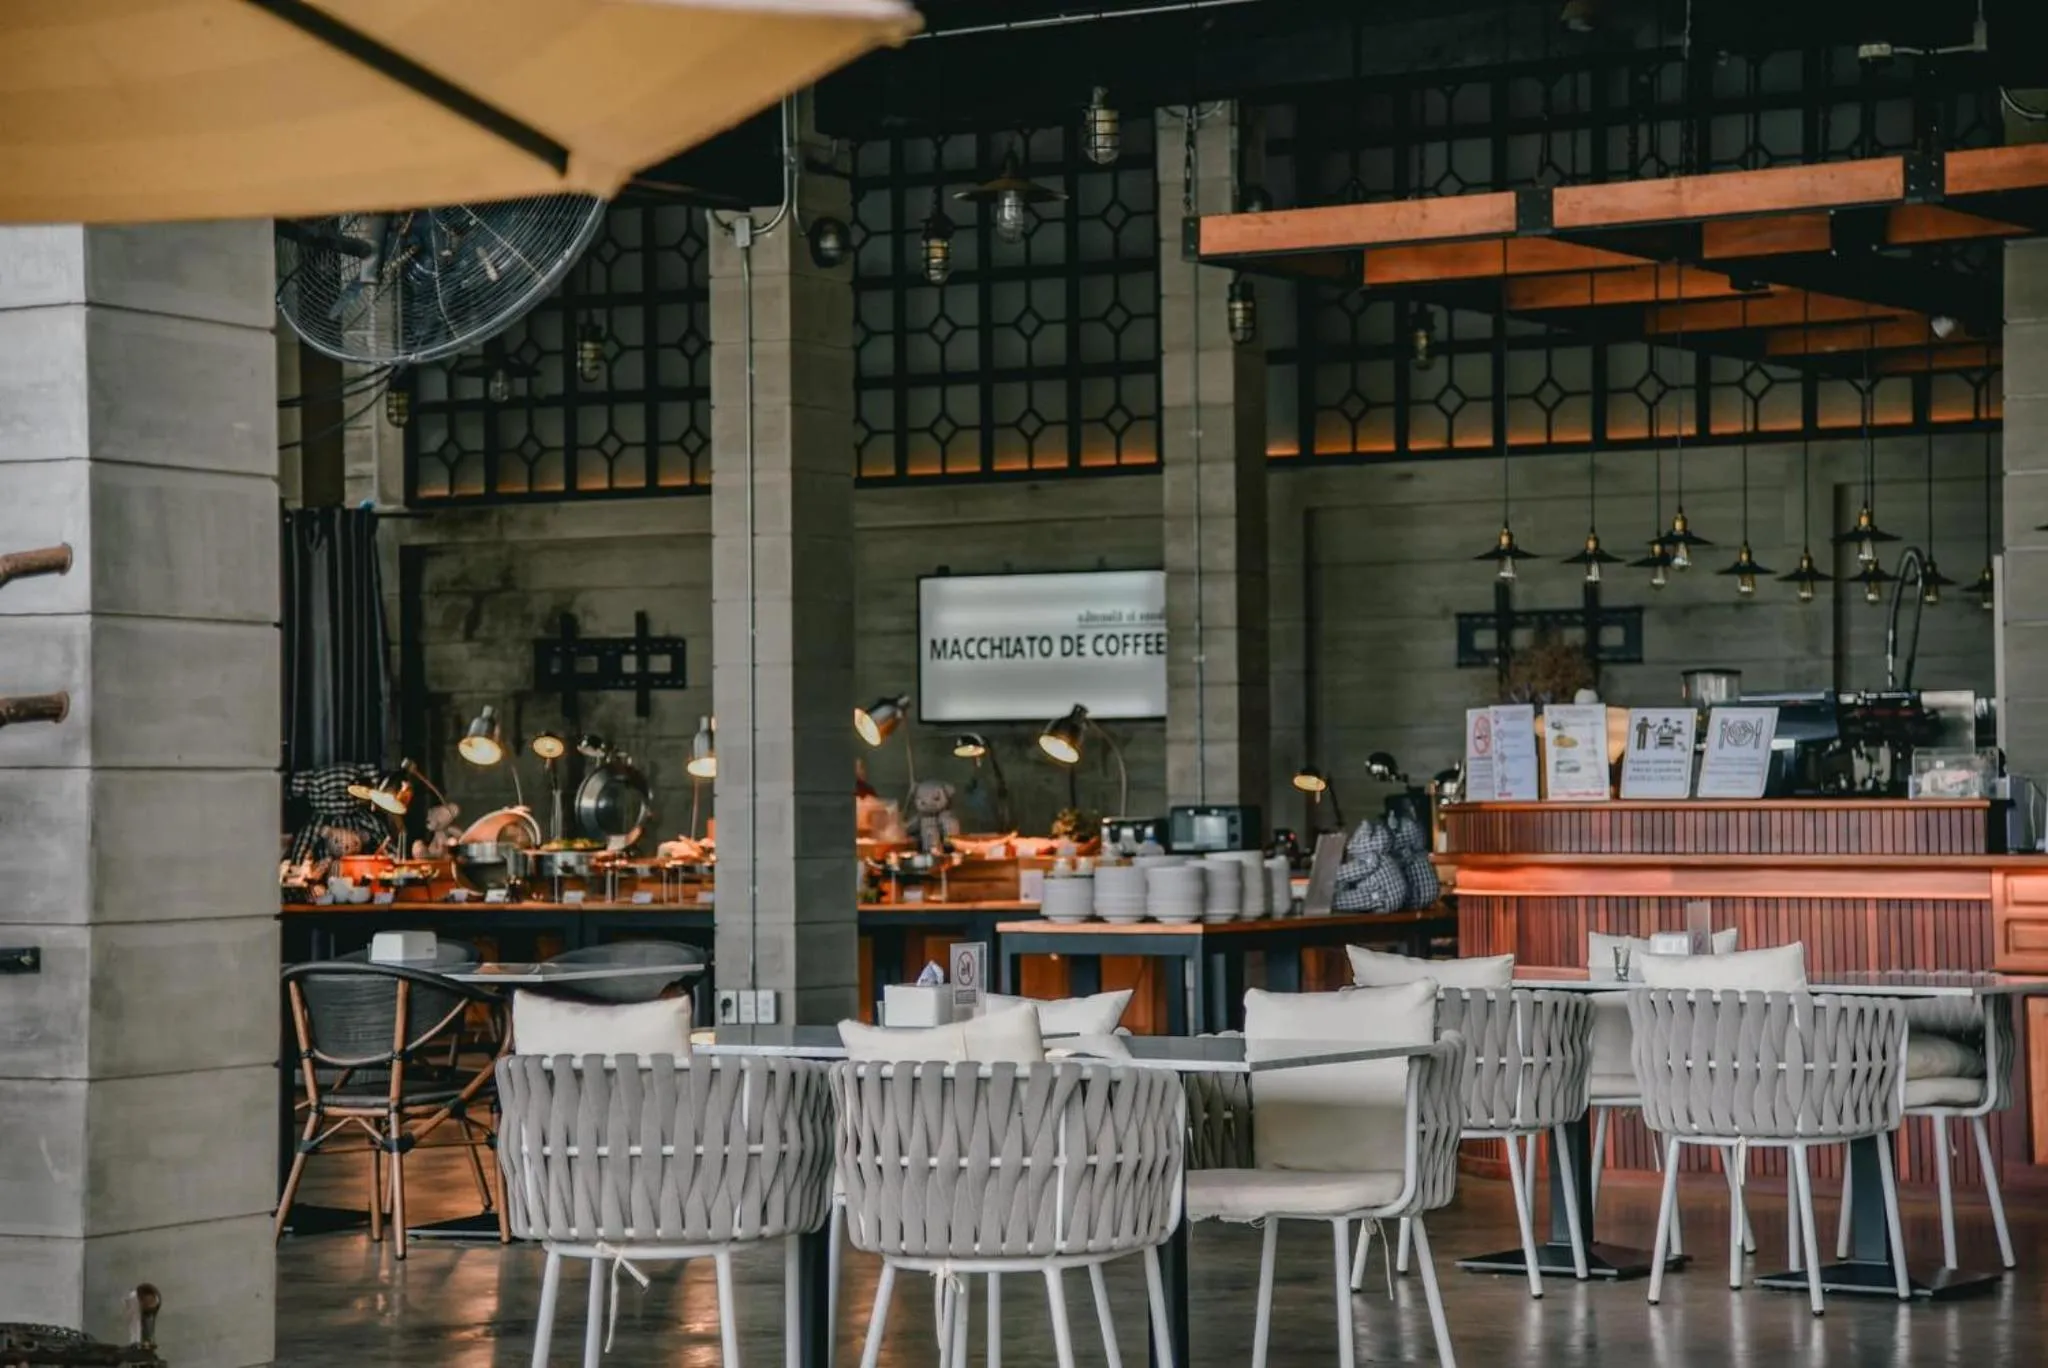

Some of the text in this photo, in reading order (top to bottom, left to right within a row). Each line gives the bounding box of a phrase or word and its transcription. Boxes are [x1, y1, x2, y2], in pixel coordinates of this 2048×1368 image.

[930, 632, 1166, 660] MACCHIATO DE COFFEE
